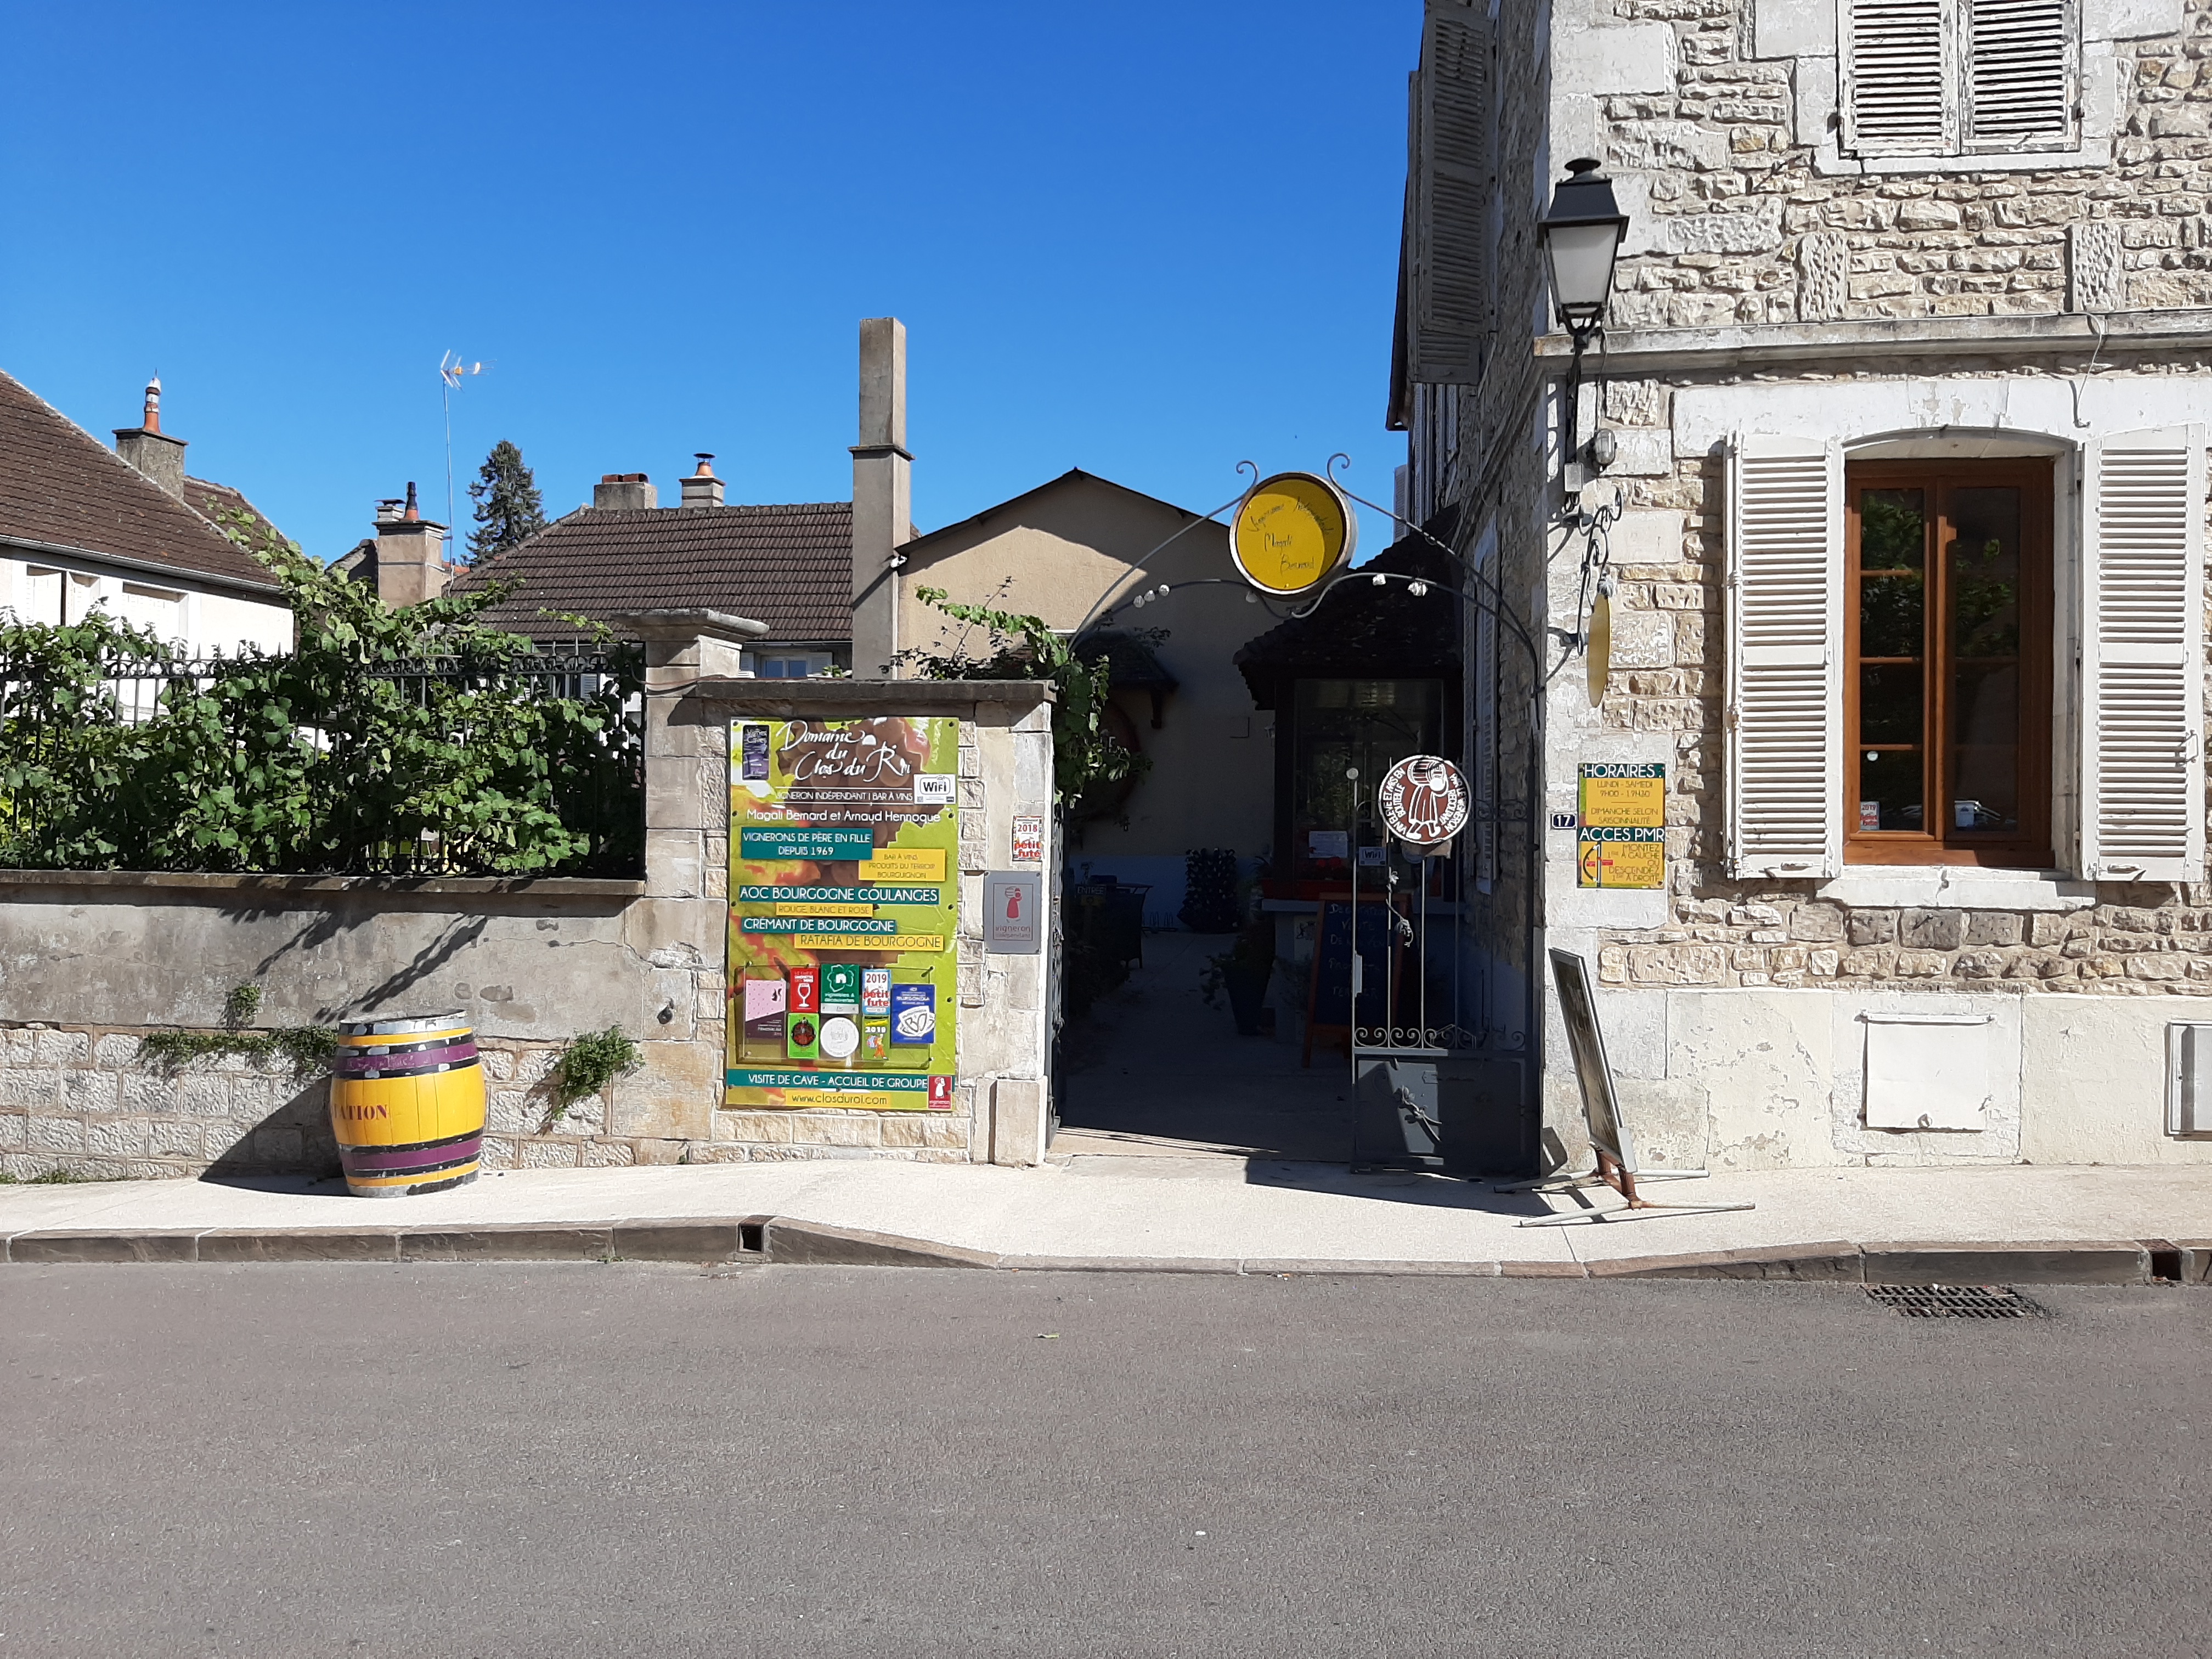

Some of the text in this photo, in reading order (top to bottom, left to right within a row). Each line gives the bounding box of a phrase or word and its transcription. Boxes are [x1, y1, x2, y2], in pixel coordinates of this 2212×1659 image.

[776, 720, 865, 751] Domaine
[826, 742, 848, 759] du
[795, 751, 843, 781] Clos
[843, 758, 866, 775] du
[1584, 764, 1655, 778] HORAIRES
[873, 792, 887, 800] BAR
[896, 793, 913, 801] VINS
[747, 808, 783, 821] Magali
[786, 809, 827, 820] Bernard
[830, 811, 841, 820] et
[844, 810, 882, 821] Arnaud
[1556, 815, 1571, 826] 17
[743, 832, 795, 842] VIGNERONS
[798, 833, 810, 842] DE
[835, 833, 848, 842] EN
[850, 834, 870, 843] FILLE
[1579, 827, 1664, 842] ACCES PMR
[778, 845, 834, 855] DEPUIS 1969
[1622, 844, 1660, 852] MONTEZ
[740, 887, 938, 901] AOC BOURGOGNE COULANGES
[800, 919, 814, 930] DE
[817, 919, 894, 932] BOURGOGNE
[800, 935, 941, 947] RATAFIA DE BOURGOGNE
[866, 973, 887, 983] 2019
[748, 1074, 775, 1084] VISITE
[778, 1075, 791, 1085] DE
[793, 1075, 819, 1085] CAVE
[827, 1076, 870, 1087] ACCUEIL
[872, 1077, 884, 1087] DE
[887, 1078, 928, 1088] GROUPE
